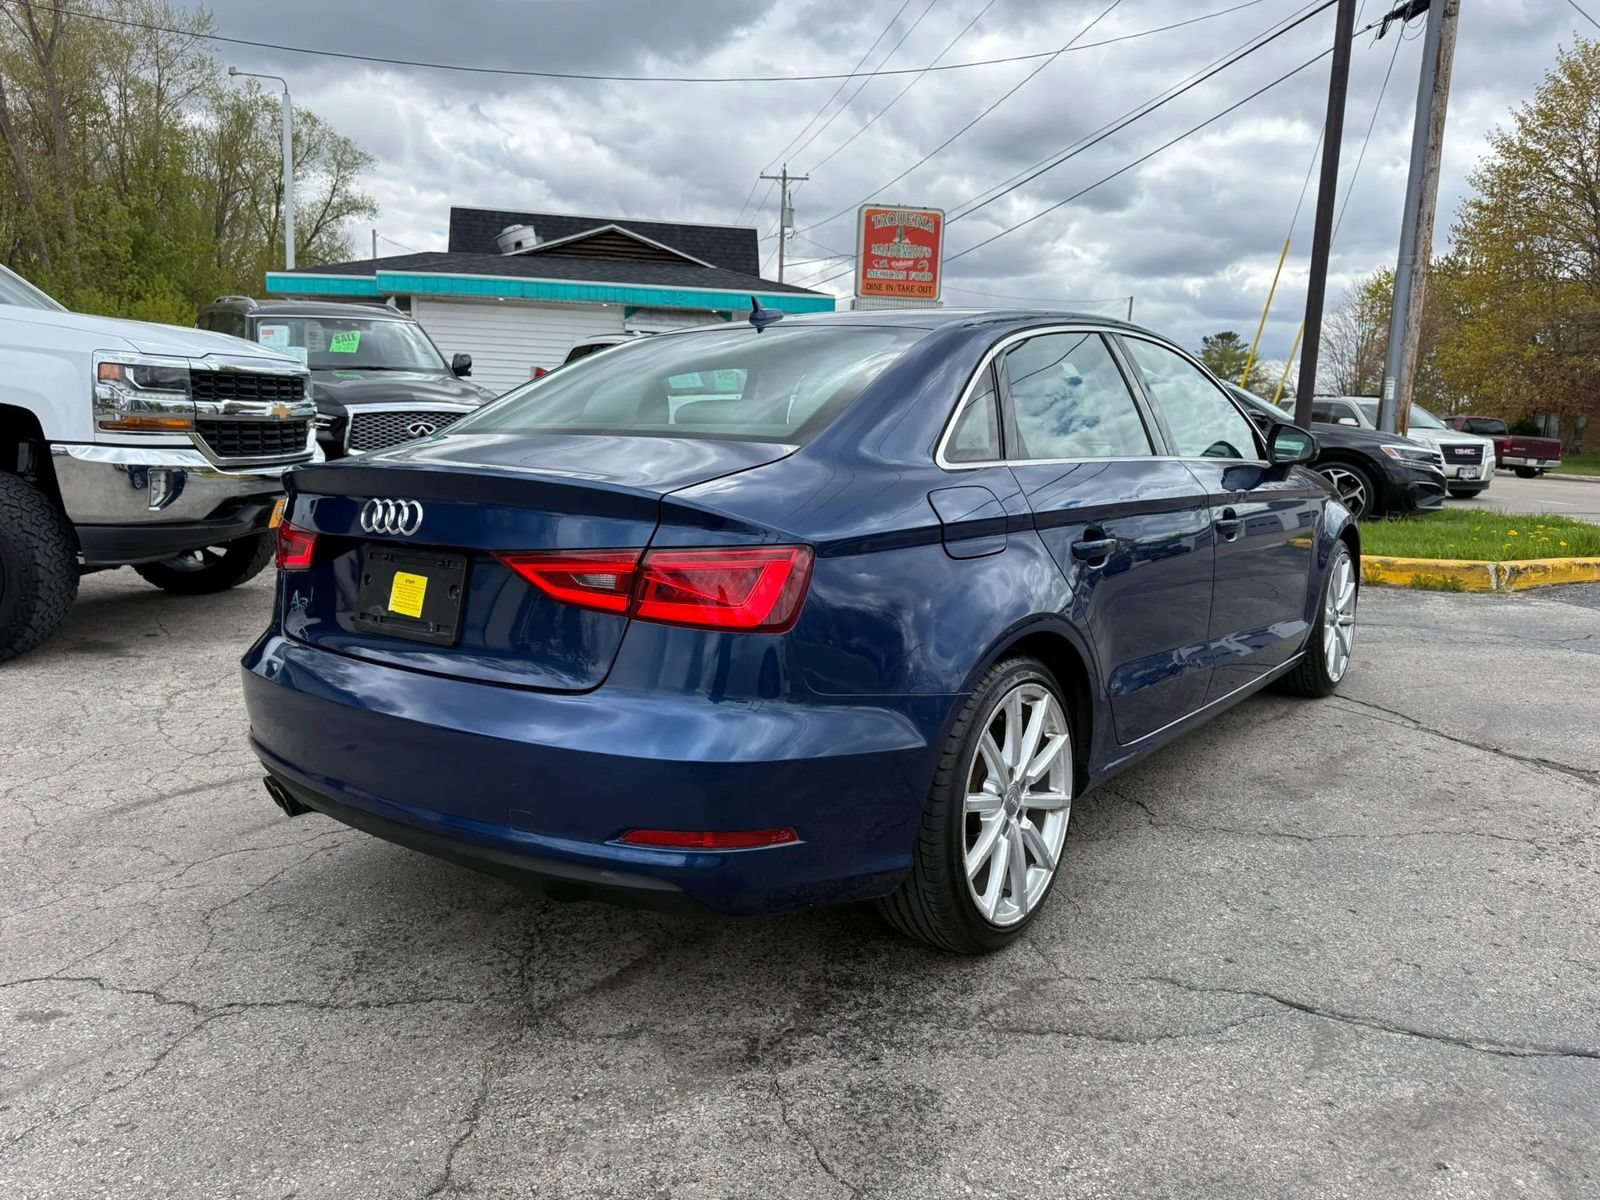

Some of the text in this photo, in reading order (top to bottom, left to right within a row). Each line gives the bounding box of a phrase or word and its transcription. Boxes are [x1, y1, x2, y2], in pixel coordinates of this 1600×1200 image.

[872, 211, 935, 234] TAQUERIA
[866, 282, 883, 291] DINE
[917, 285, 932, 294] OUT
[334, 333, 358, 344] SALE
[290, 589, 308, 609] A3
